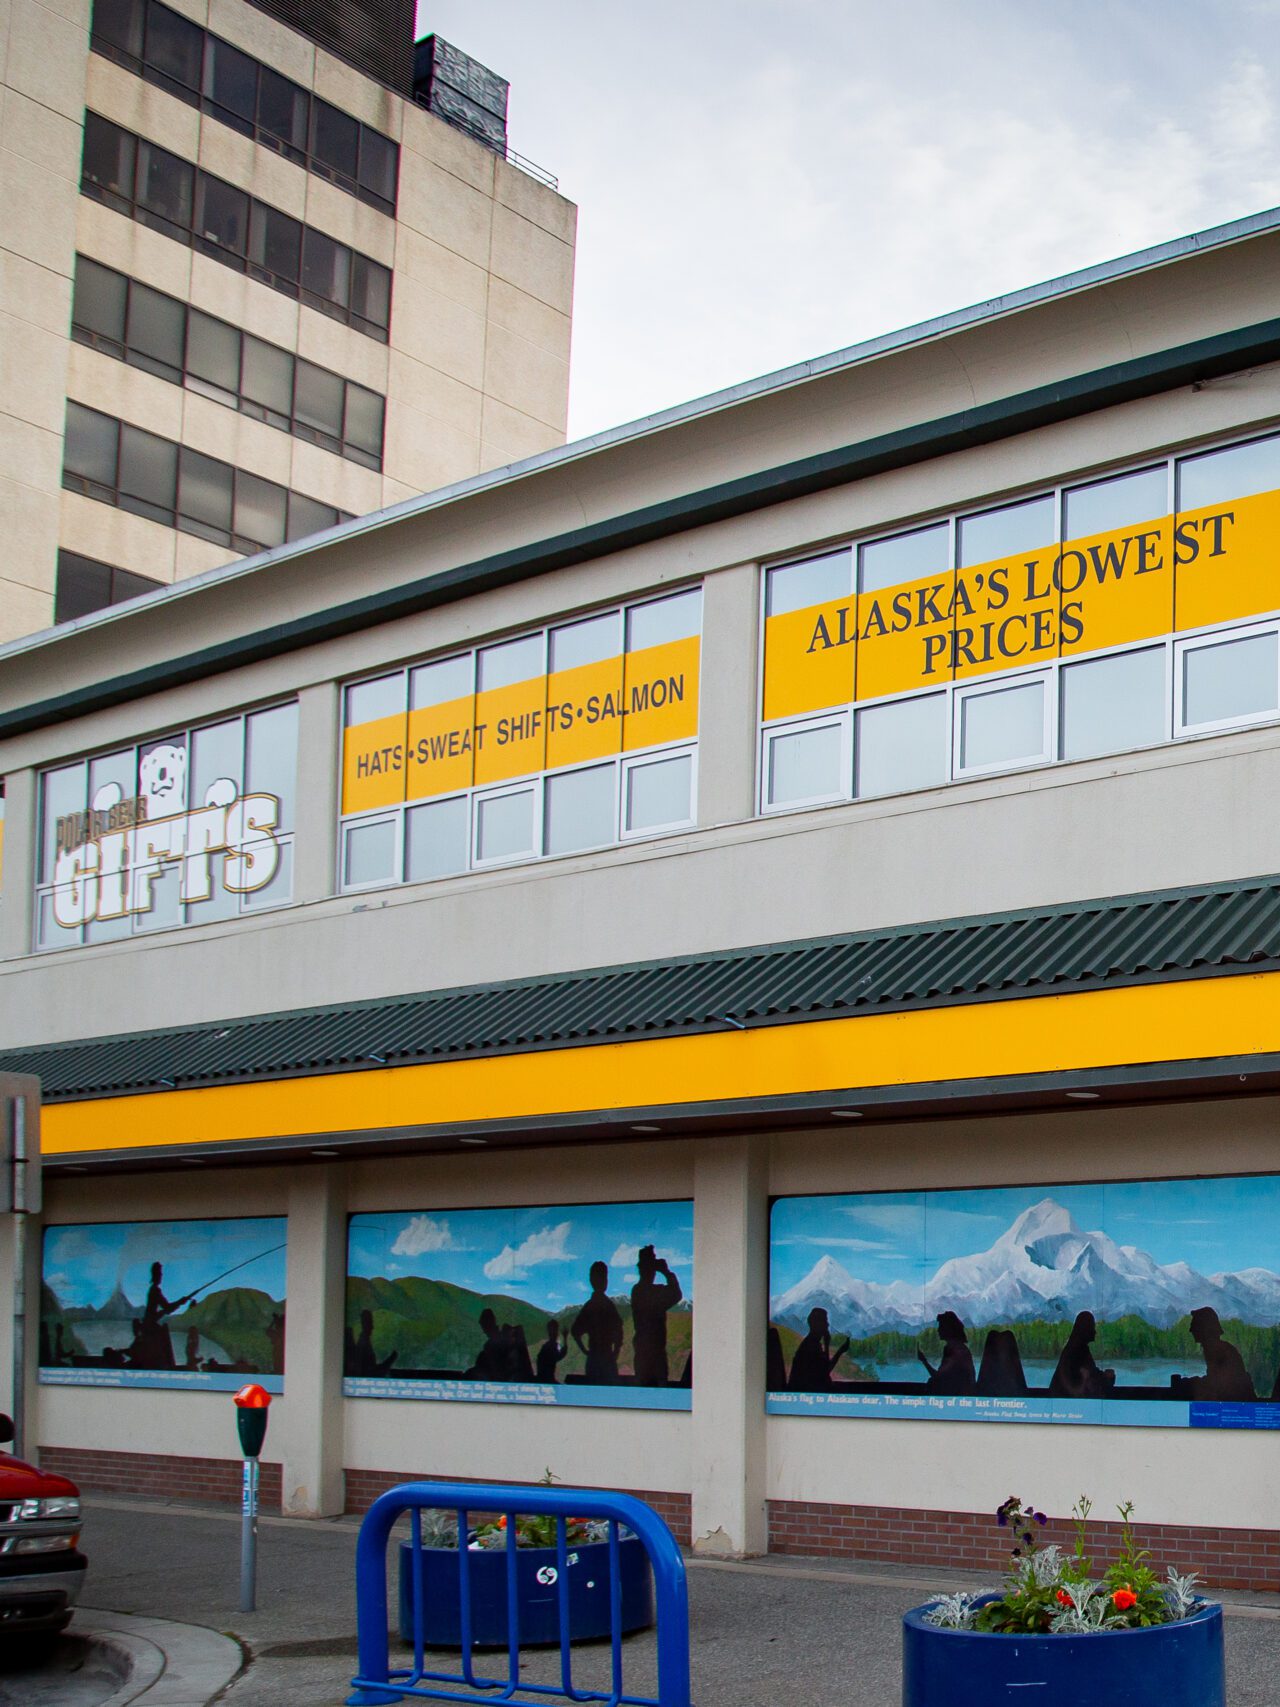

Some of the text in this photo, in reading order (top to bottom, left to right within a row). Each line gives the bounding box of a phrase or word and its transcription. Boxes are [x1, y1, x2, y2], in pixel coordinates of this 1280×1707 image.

[806, 512, 1235, 654] ALASKA'S LOWEST
[921, 601, 1084, 675] PRICES
[53, 792, 281, 928] GIFTS
[885, 1395, 898, 1405] The
[902, 1397, 925, 1409] simple
[929, 1398, 944, 1409] flag
[947, 1398, 956, 1407] of
[959, 1398, 972, 1407] the
[975, 1398, 990, 1408] last
